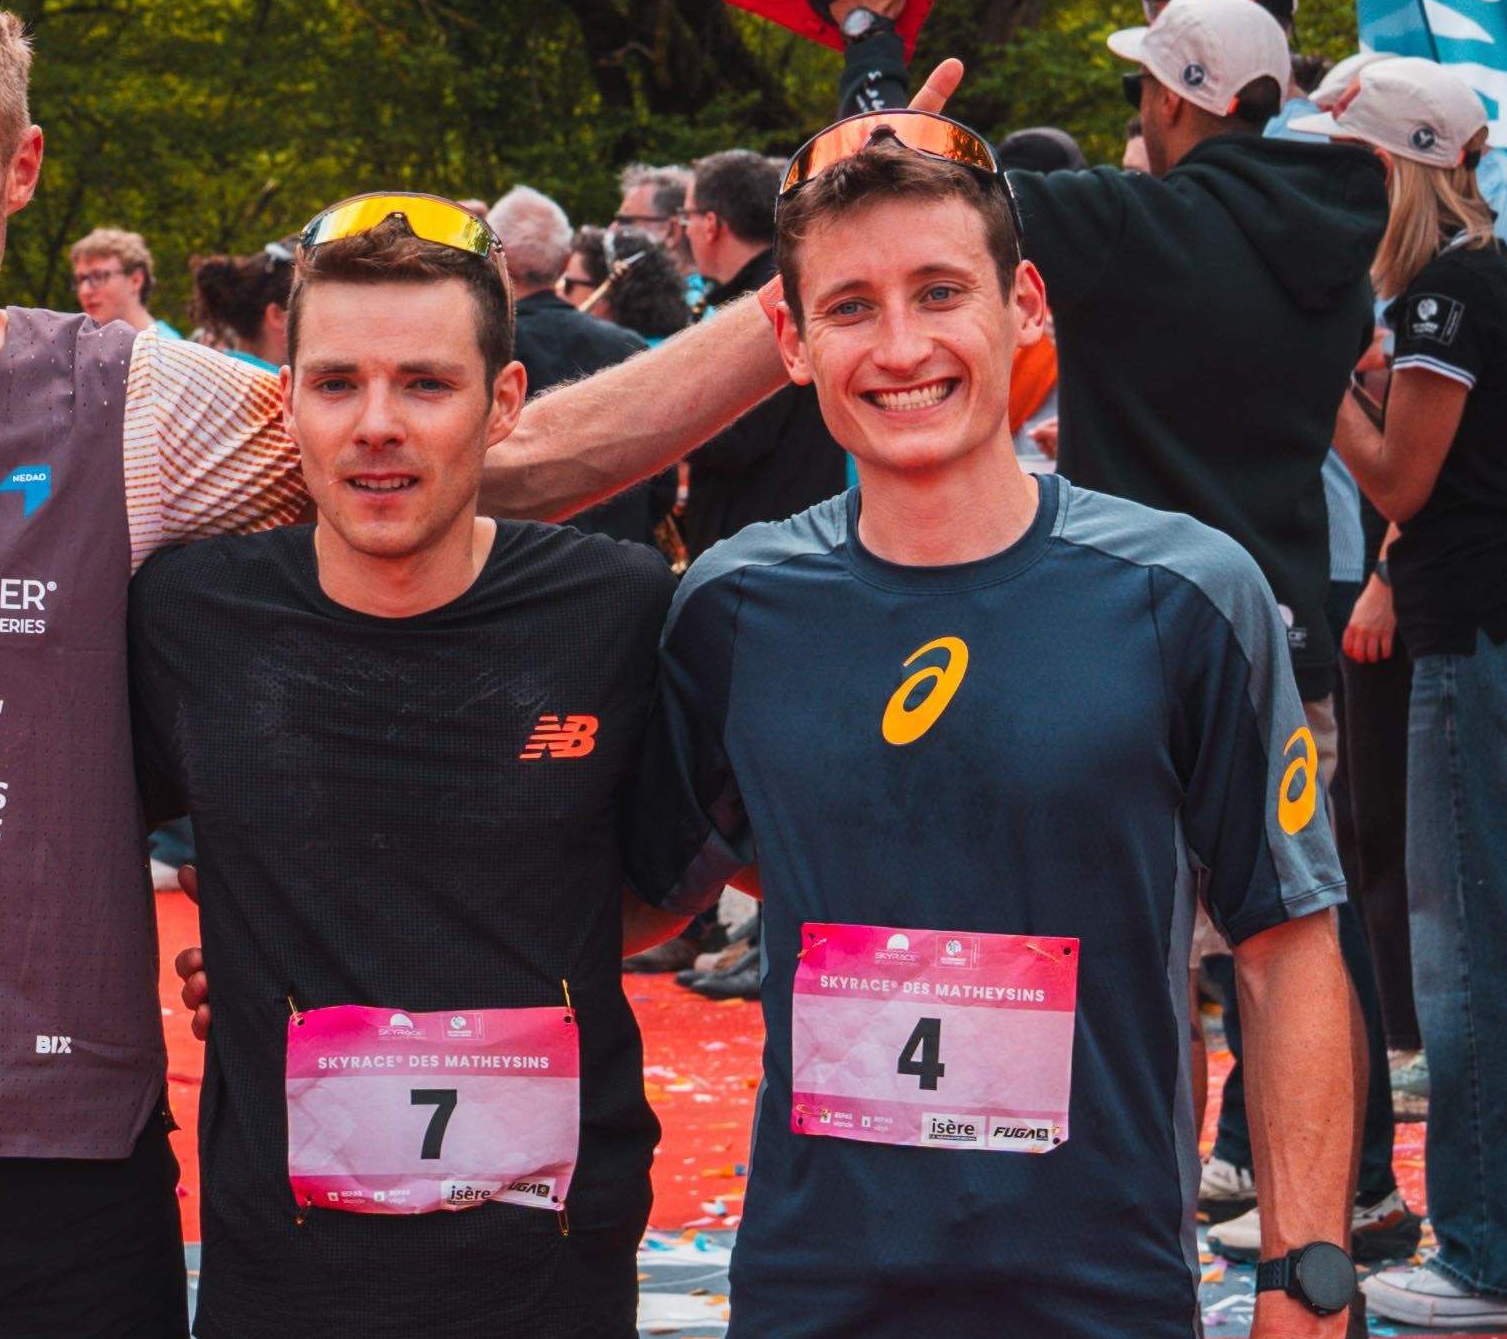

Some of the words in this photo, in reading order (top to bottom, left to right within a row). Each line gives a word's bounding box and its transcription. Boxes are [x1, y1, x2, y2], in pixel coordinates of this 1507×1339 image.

[12, 472, 47, 483] NEDAO
[519, 714, 599, 760] NB
[903, 981, 930, 994] DES
[935, 983, 1045, 1002] MATHEYSINS
[36, 1035, 72, 1055] BIX
[897, 1017, 945, 1092] 4
[409, 1055, 438, 1068] DES
[445, 1055, 549, 1069] MATHEYSINS
[410, 1088, 458, 1159] 7
[931, 1118, 975, 1136] isère
[450, 1185, 491, 1201] isère
[508, 1179, 537, 1195] UGA
